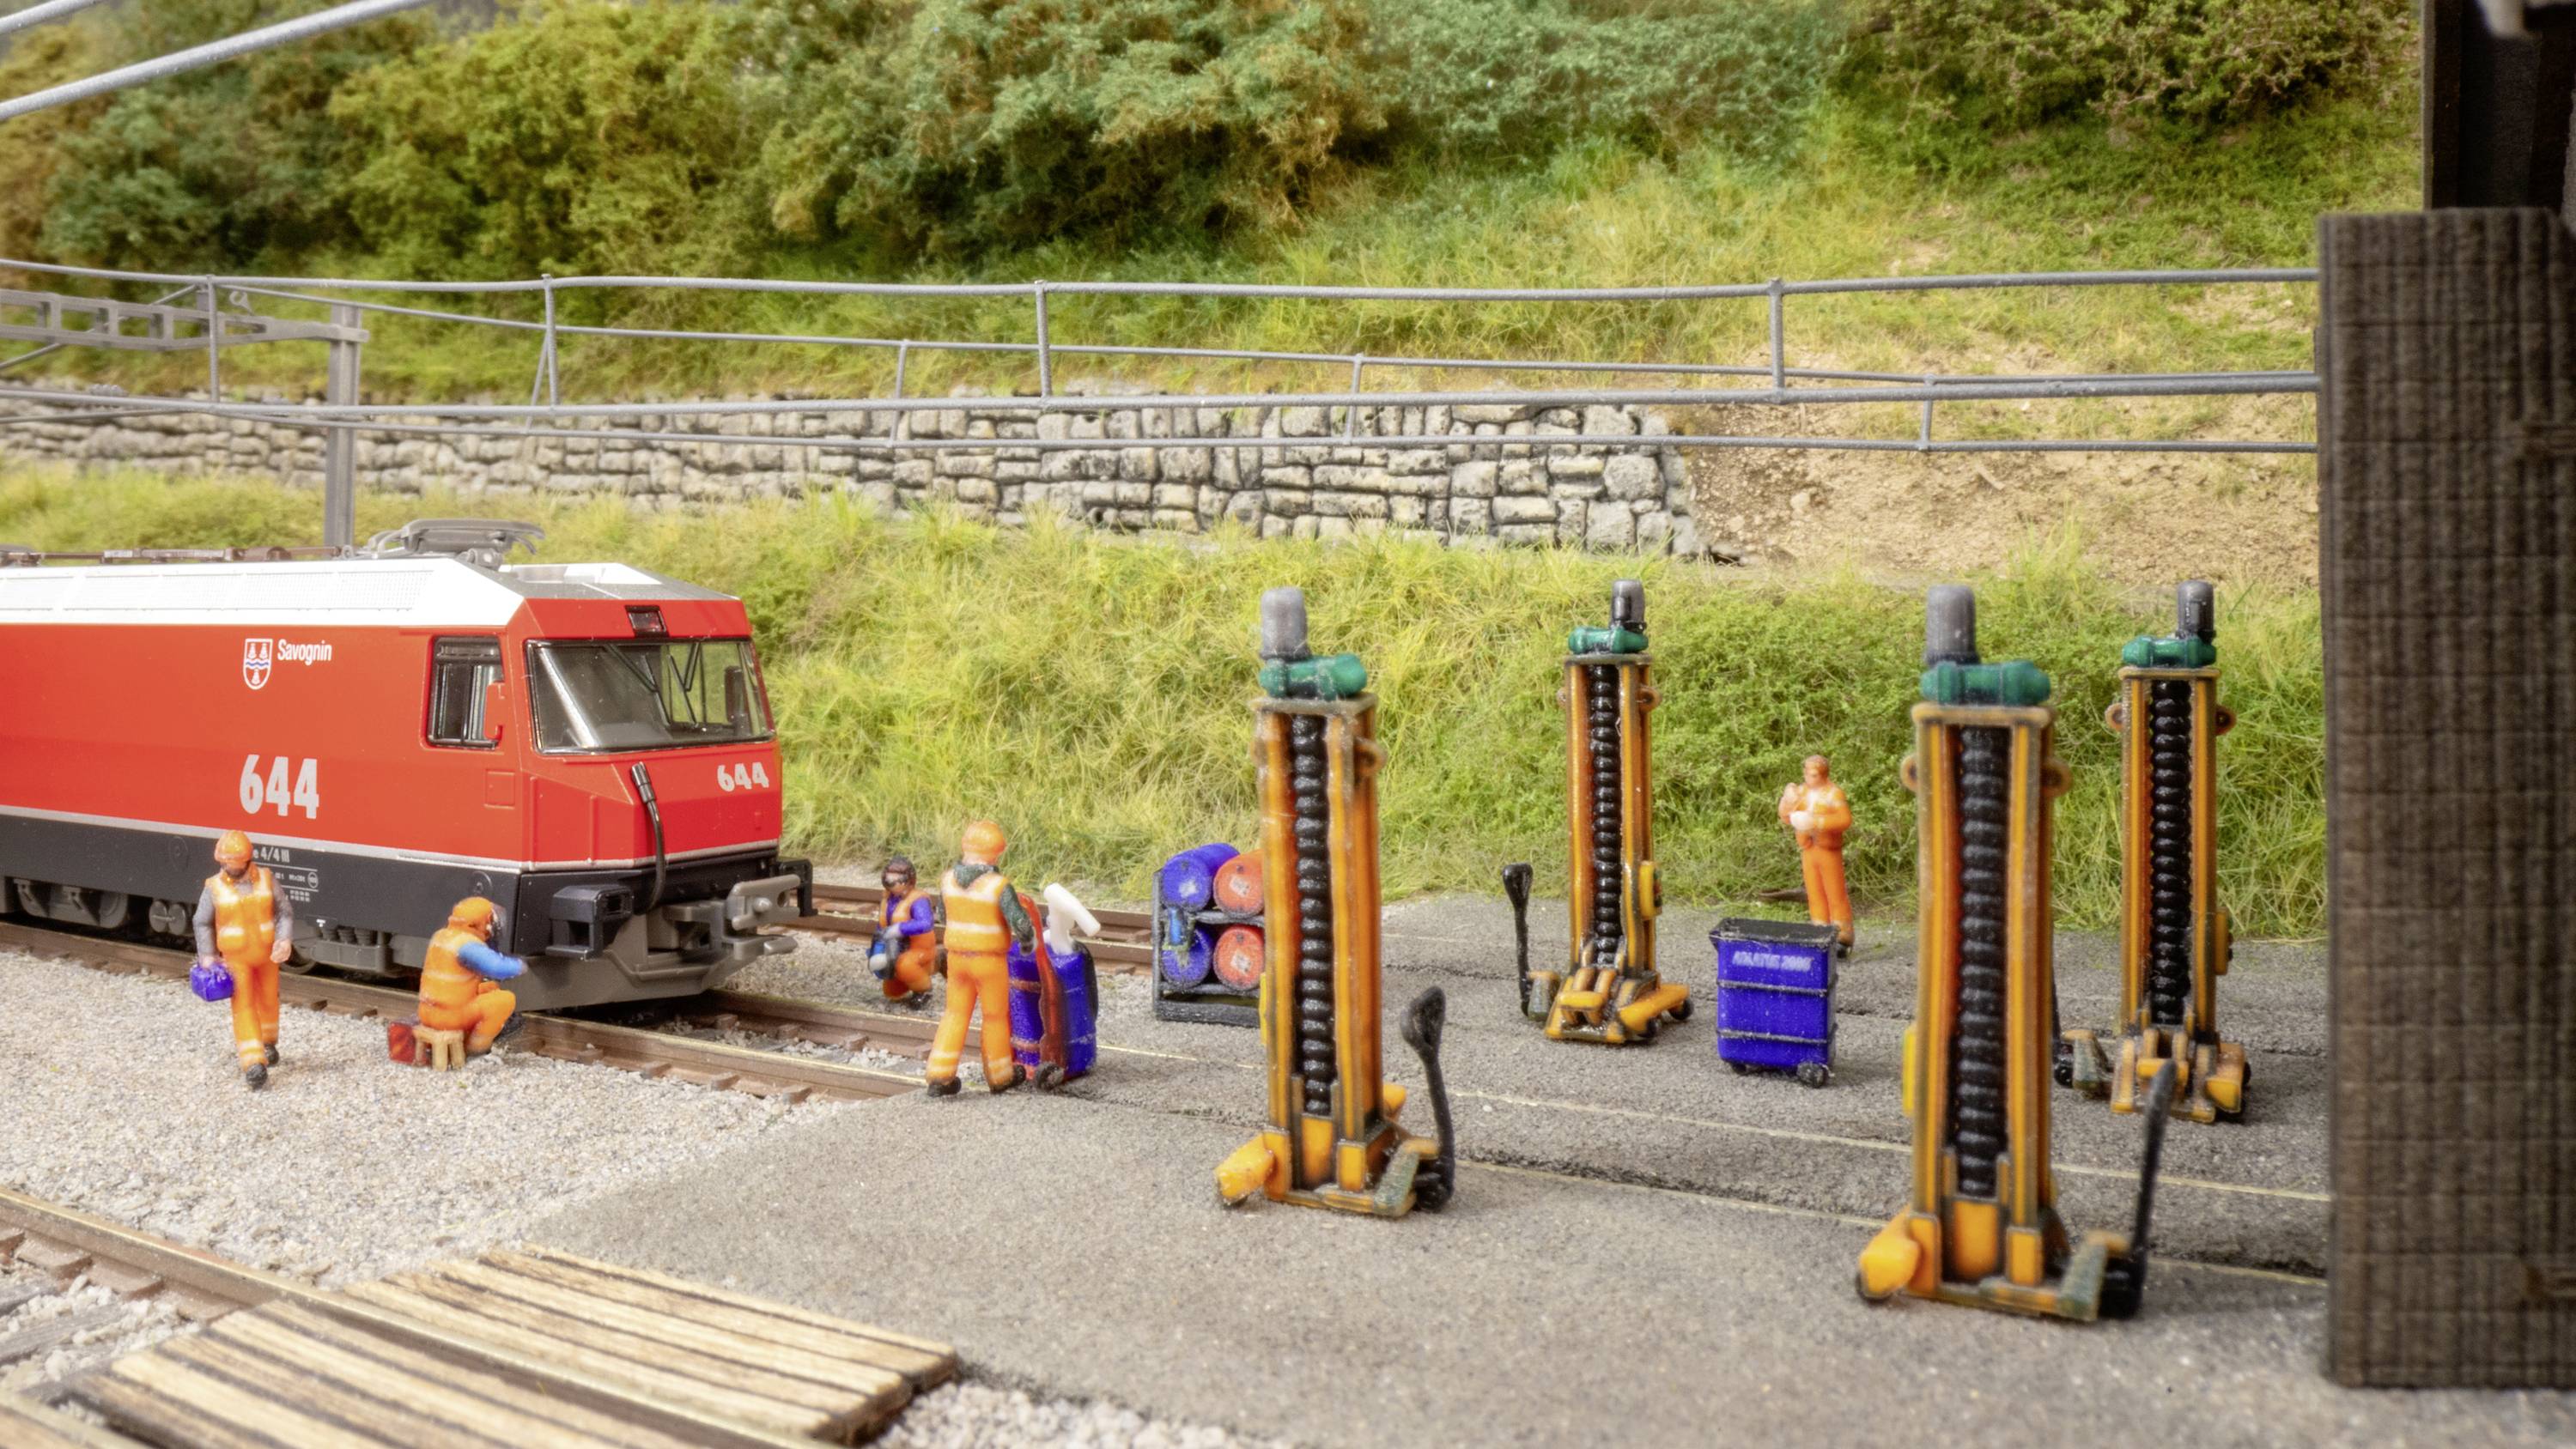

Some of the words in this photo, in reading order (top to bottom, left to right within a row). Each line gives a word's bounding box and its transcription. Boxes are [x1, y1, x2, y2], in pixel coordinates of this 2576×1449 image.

[277, 639, 332, 666] Savognin
[240, 754, 319, 820] 644
[717, 761, 770, 792] 644
[260, 846, 280, 862] 4/4
